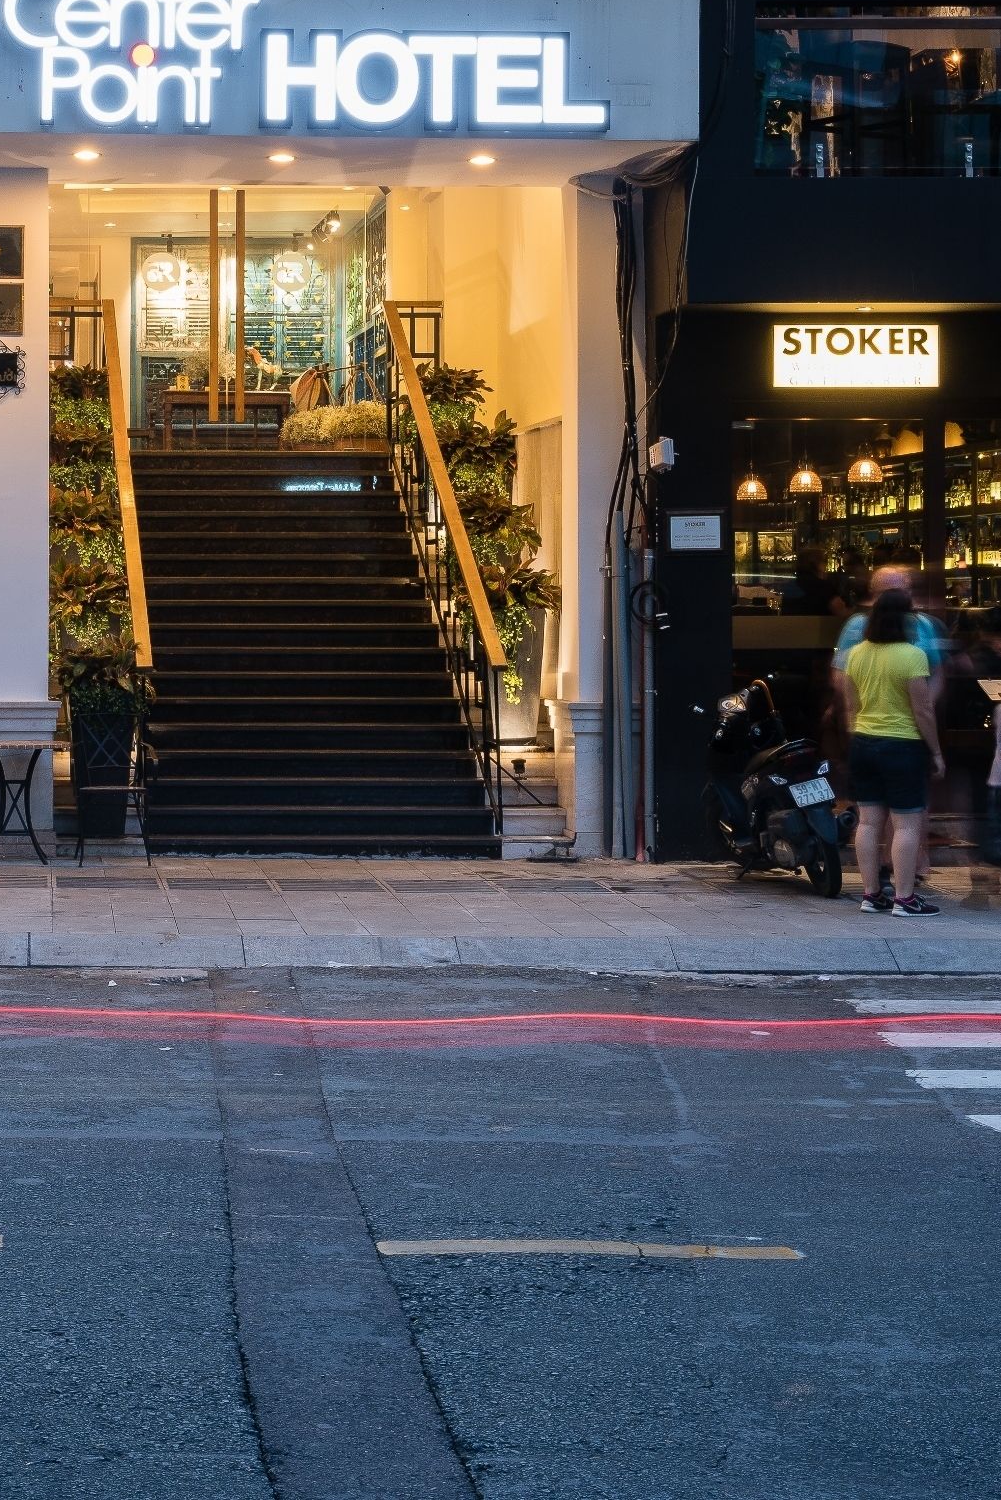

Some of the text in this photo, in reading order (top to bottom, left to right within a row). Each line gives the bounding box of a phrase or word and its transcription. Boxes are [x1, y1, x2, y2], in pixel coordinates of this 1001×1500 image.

[40, 45, 222, 124] Point
[264, 32, 606, 125] HOTEL
[782, 327, 930, 356] STOKER
